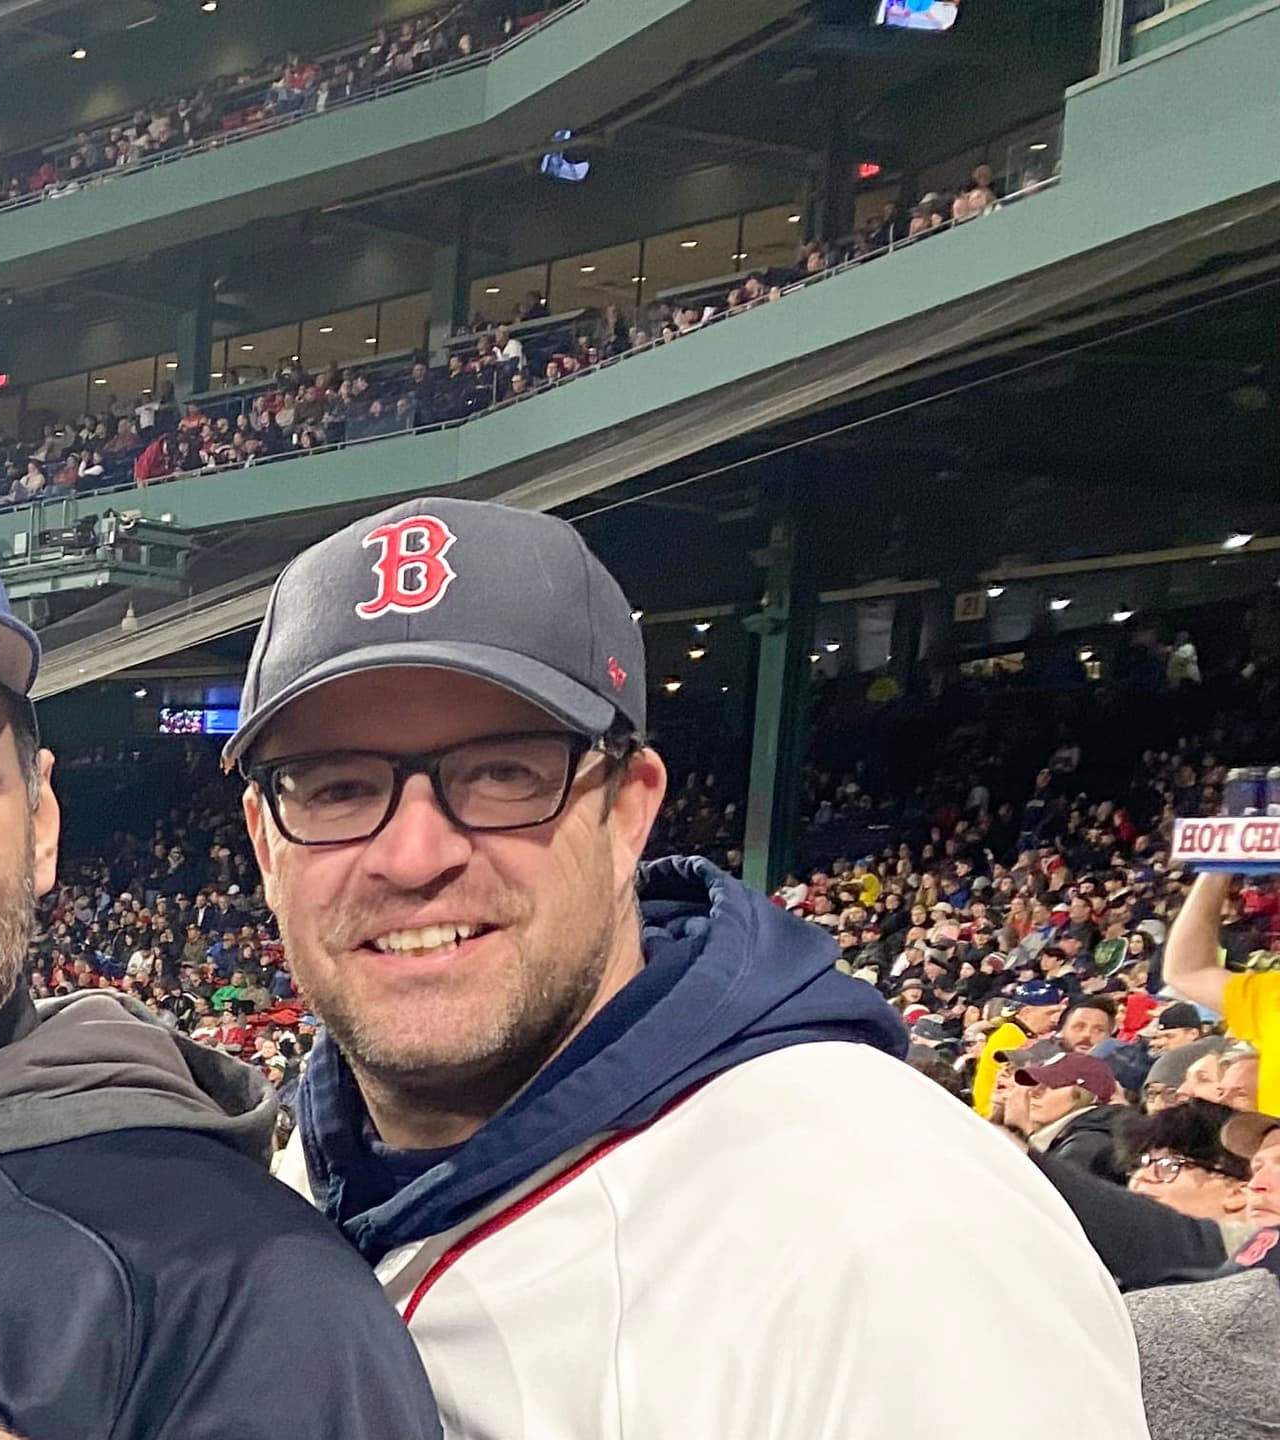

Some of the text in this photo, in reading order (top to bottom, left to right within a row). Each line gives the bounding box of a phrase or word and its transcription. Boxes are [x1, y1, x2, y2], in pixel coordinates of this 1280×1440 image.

[354, 513, 459, 621] B
[1178, 822, 1280, 853] HOT CH
